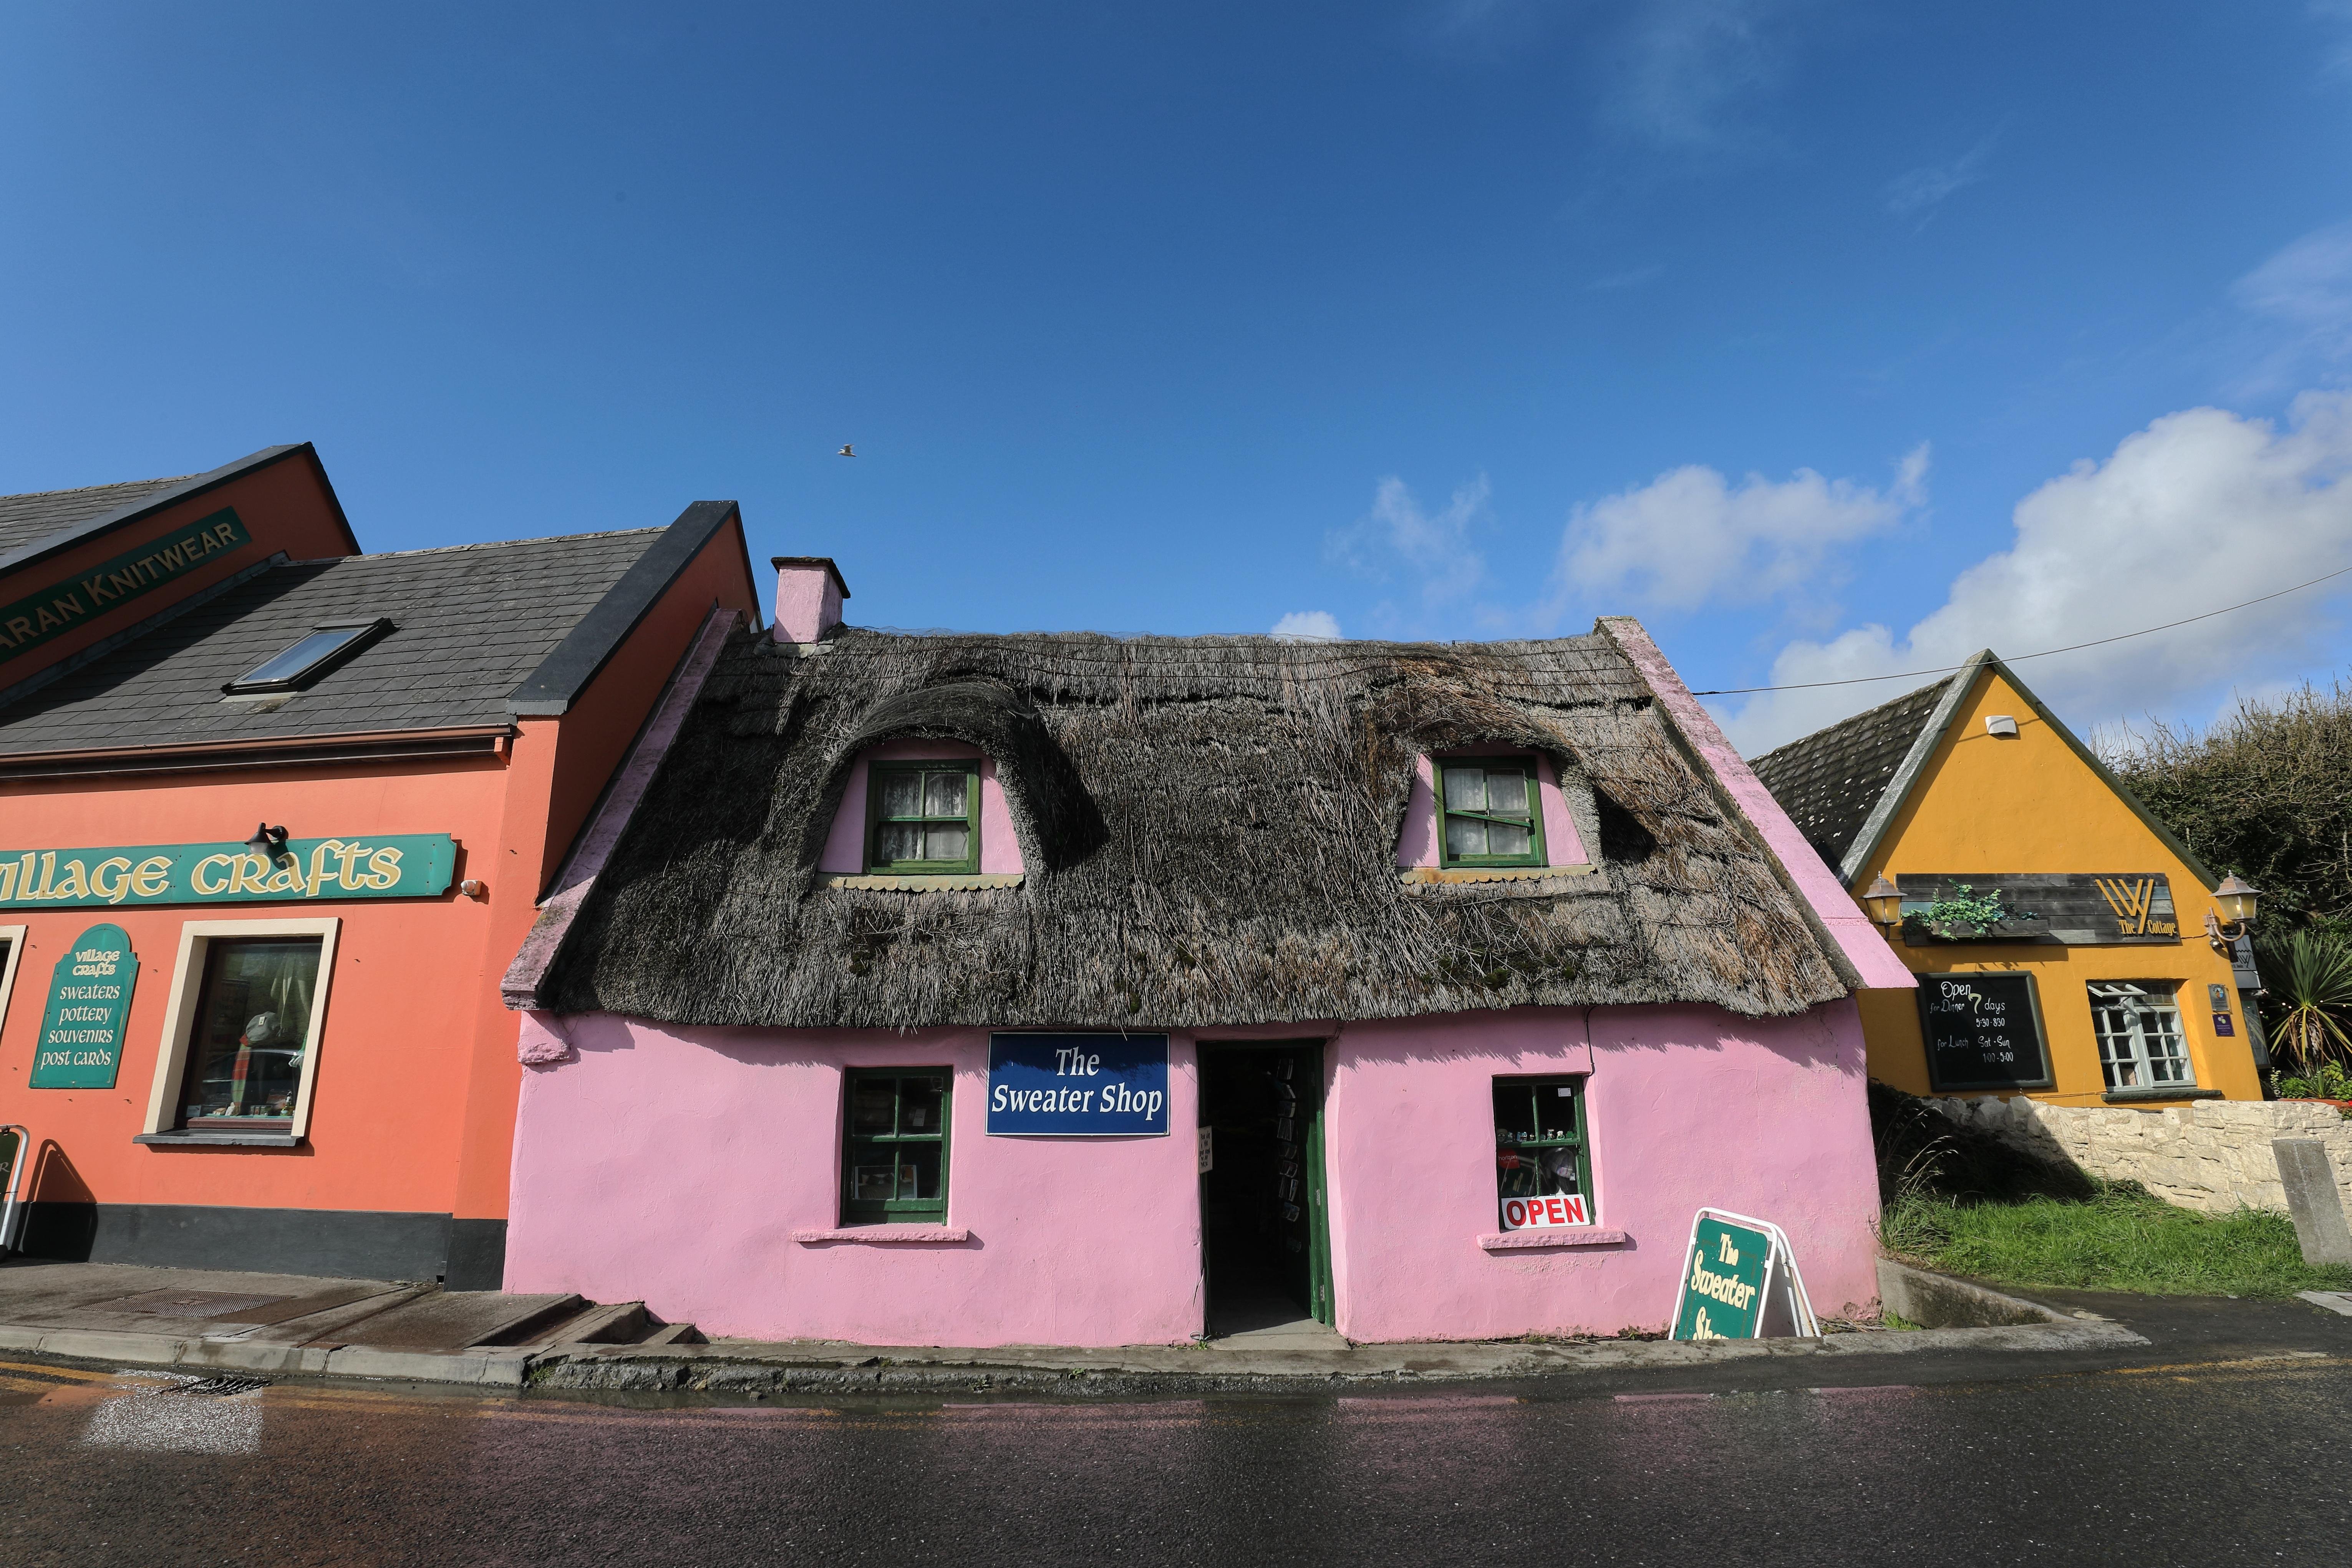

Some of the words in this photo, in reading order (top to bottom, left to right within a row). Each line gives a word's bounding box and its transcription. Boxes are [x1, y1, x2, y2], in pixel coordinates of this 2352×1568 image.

[81, 522, 239, 607] KNITWEAR
[0, 851, 174, 905] illage
[2118, 920, 2136, 934] The
[2147, 919, 2177, 936] Cottage
[1930, 1003, 1939, 1014] for
[1941, 999, 1965, 1012] Dinner
[1968, 993, 1982, 1014] 7
[1984, 998, 2005, 1014] days
[1941, 981, 1971, 1001] Open
[1938, 1039, 1947, 1051] for
[1949, 1035, 1968, 1049] Lunch
[1978, 1036, 1991, 1048] Sat
[1997, 1035, 2011, 1049] Sun
[1055, 1046, 1100, 1076] The
[991, 1084, 1094, 1114] Sweater
[1099, 1082, 1162, 1121] Shop
[1506, 1197, 1585, 1226] OPEN
[1718, 1232, 1739, 1266] The
[1691, 1249, 1756, 1311] Sweater
[1692, 1306, 1729, 1340] Sh
